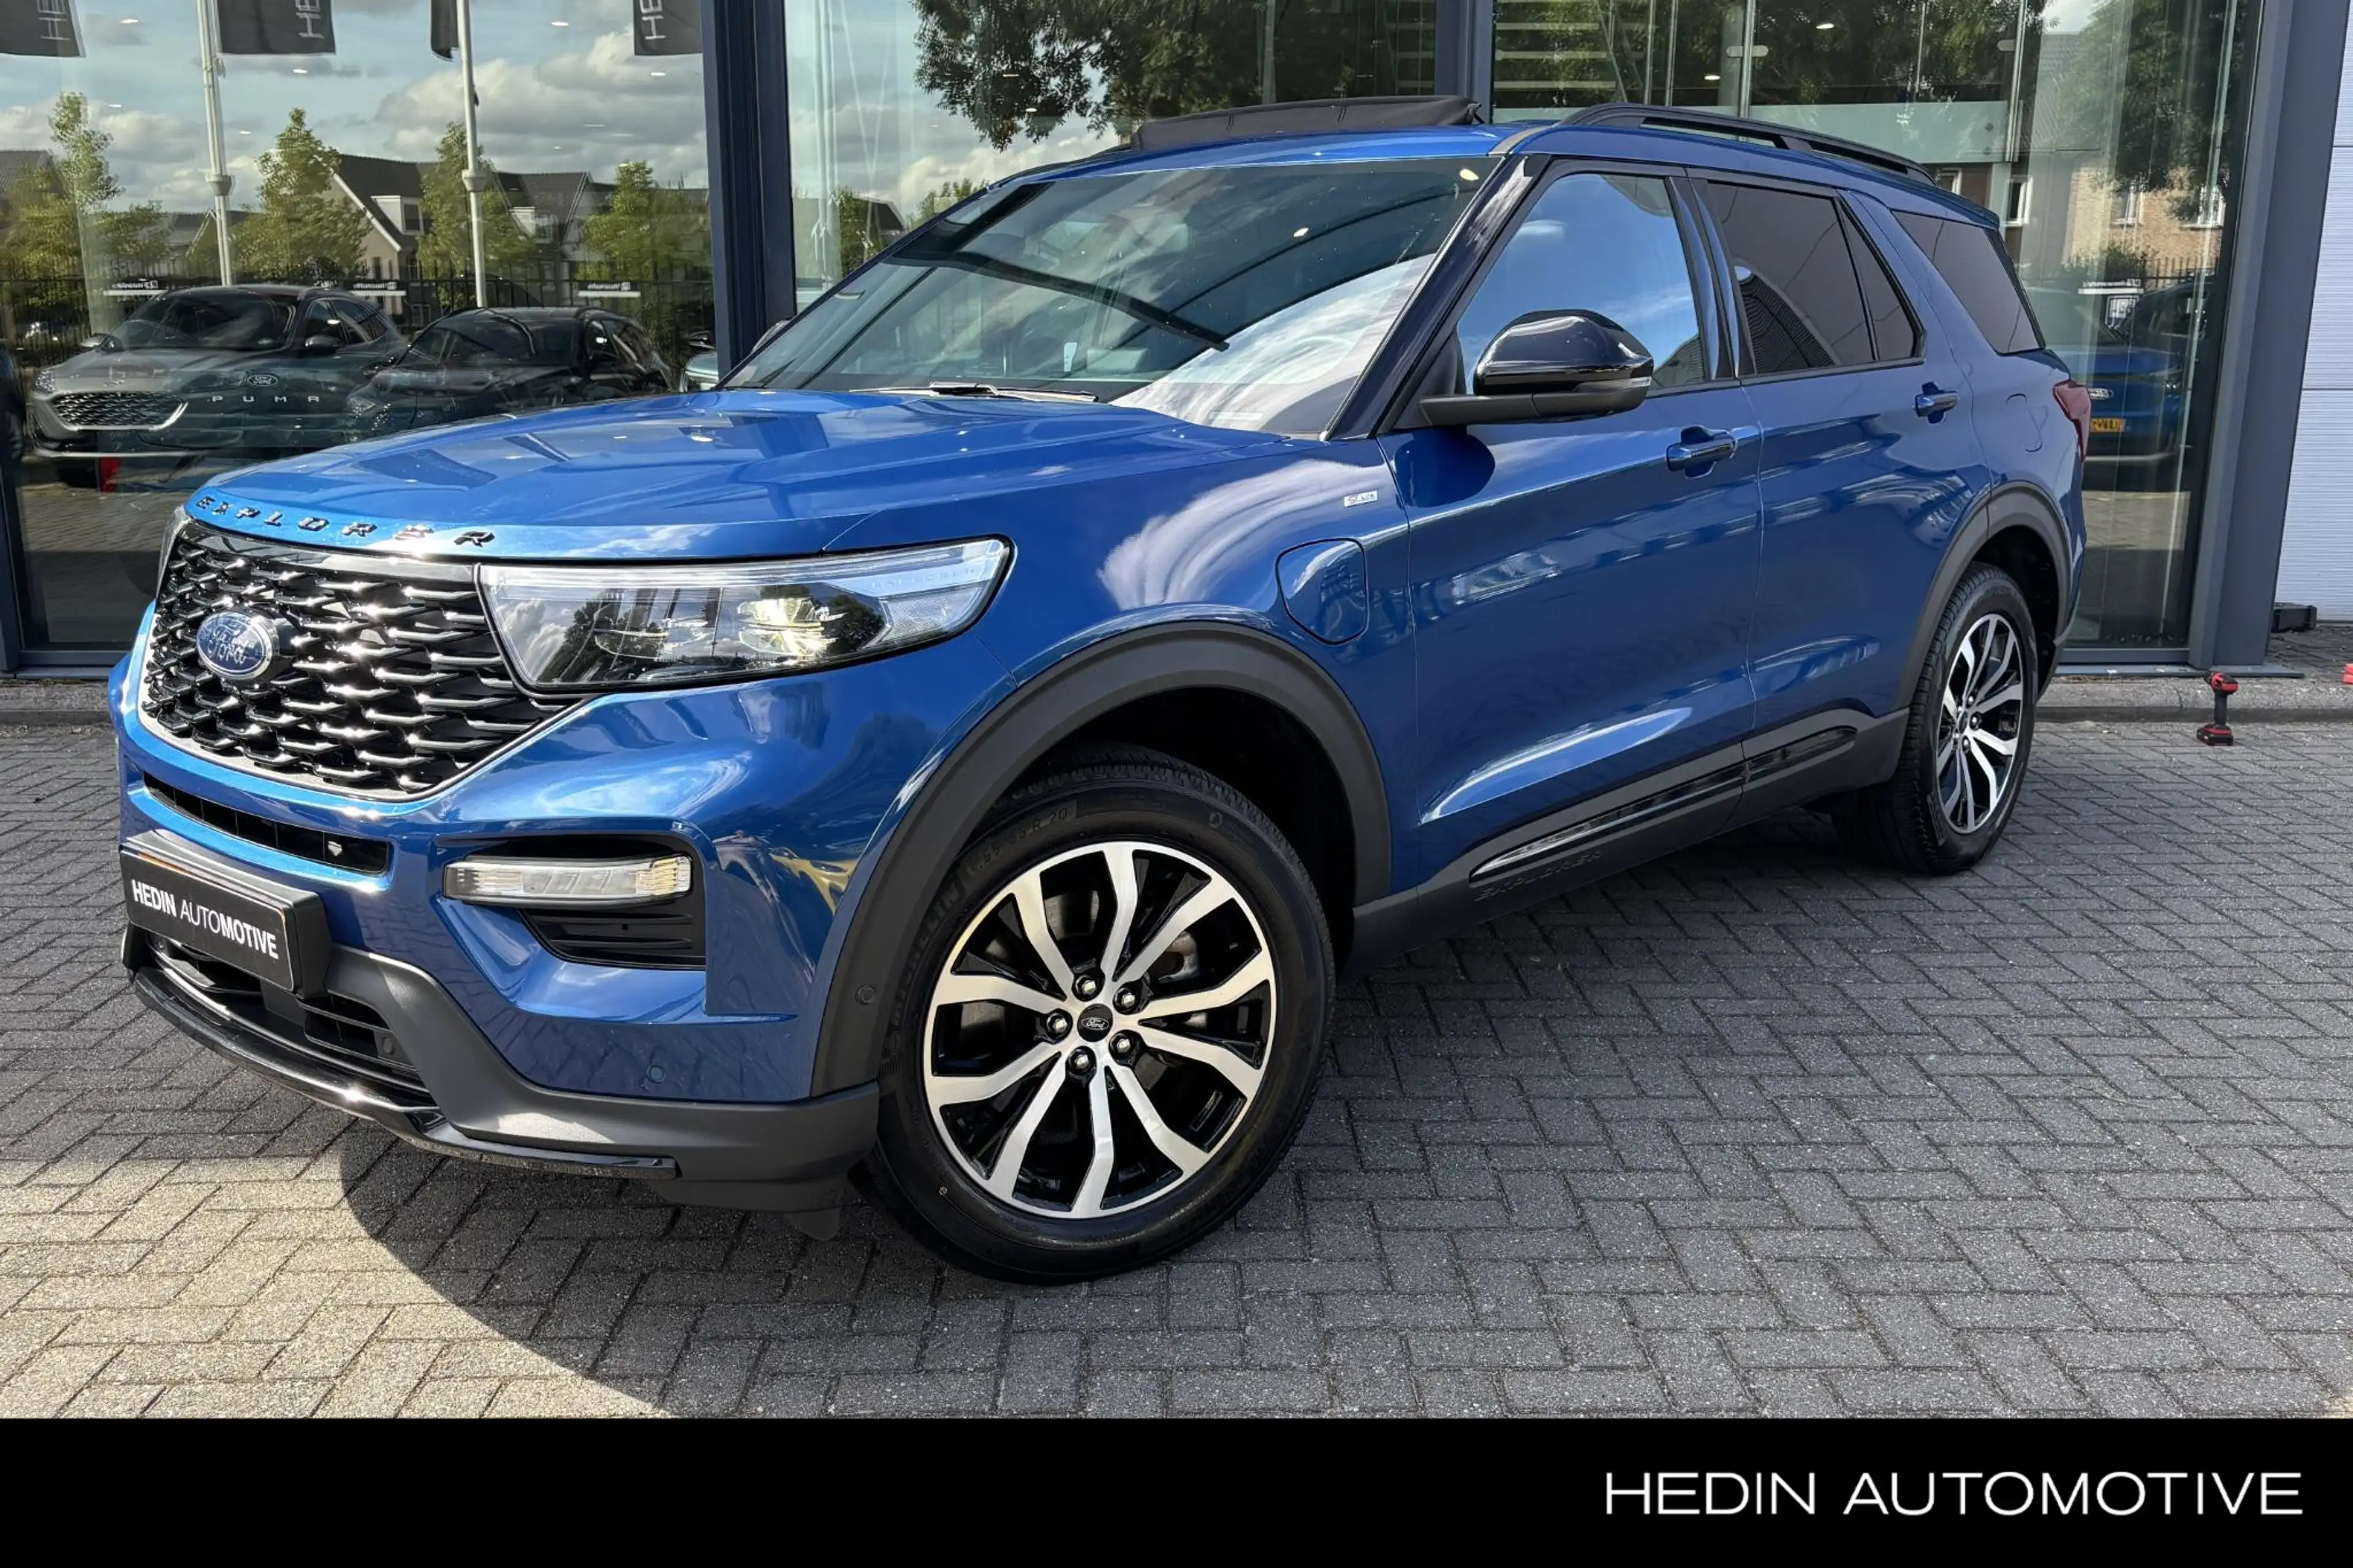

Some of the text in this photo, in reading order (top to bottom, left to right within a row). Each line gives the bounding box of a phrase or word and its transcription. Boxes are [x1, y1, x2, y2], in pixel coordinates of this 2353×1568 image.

[212, 395, 320, 403] PUMA
[195, 494, 496, 548] EXPLORER
[131, 879, 280, 960] HEDIN AUTOMOTIVE
